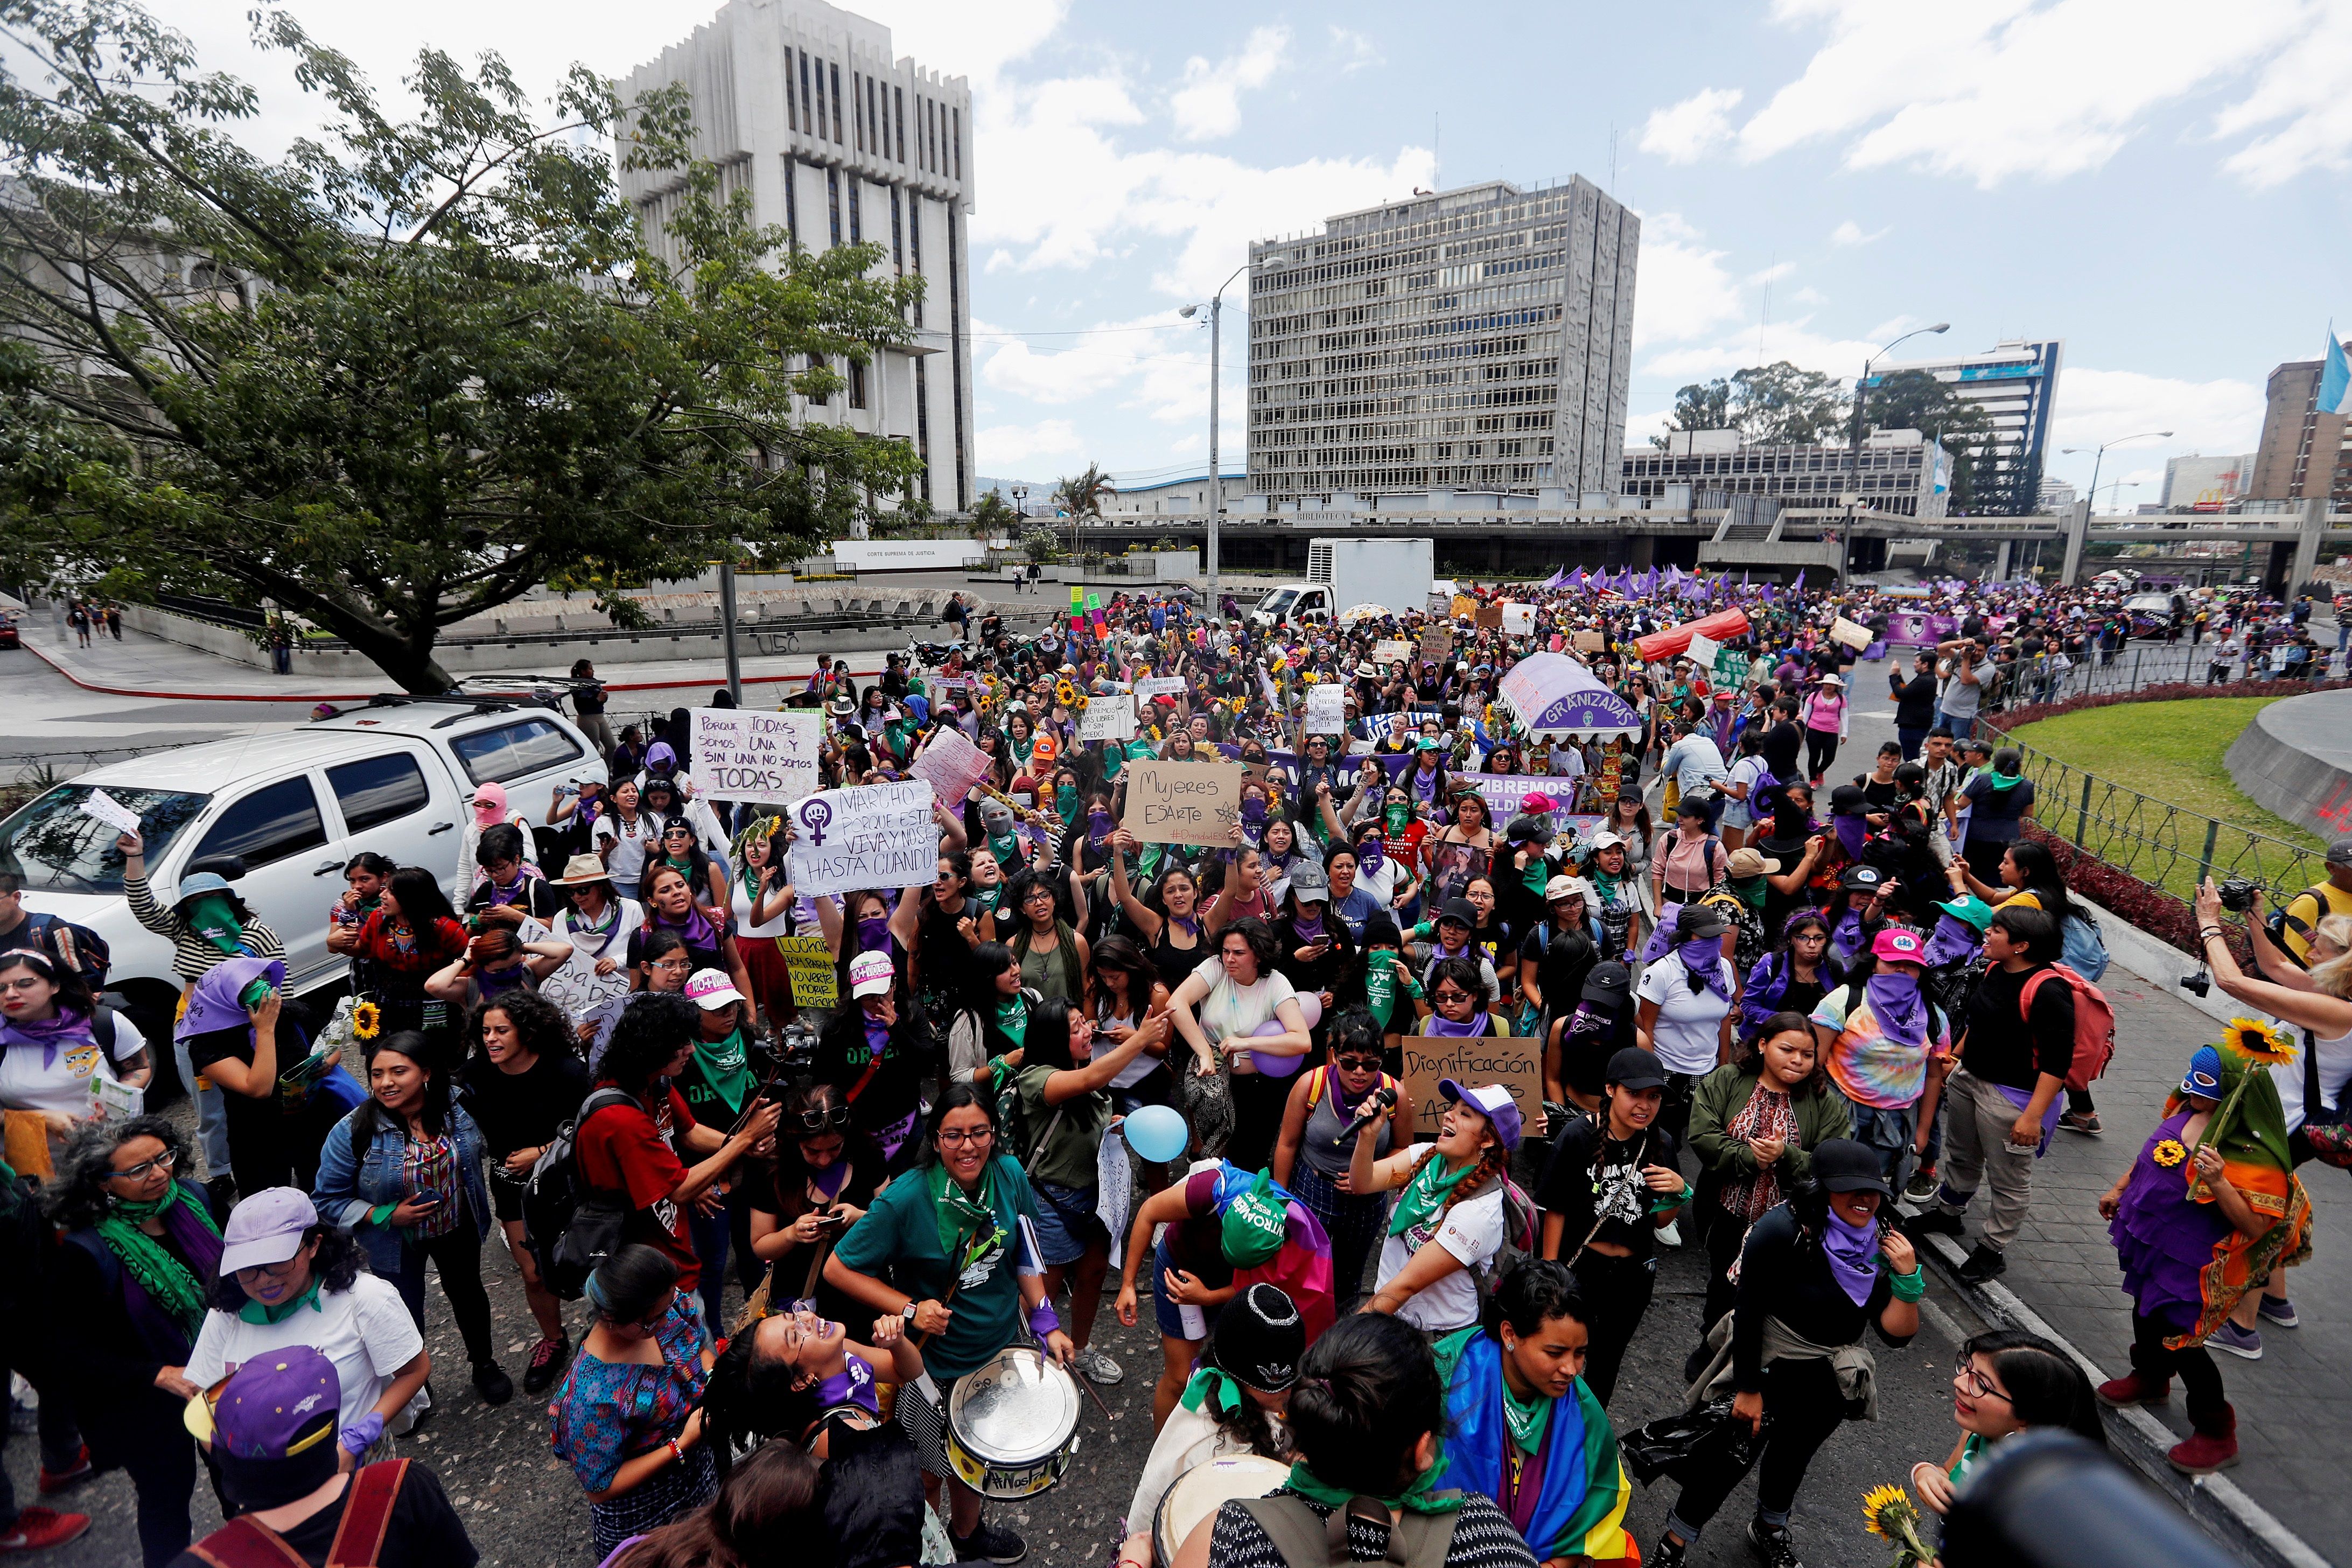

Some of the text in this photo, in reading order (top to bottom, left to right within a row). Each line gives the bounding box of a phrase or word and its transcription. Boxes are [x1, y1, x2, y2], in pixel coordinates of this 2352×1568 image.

[1425, 634, 1445, 642] MEMORIA
[1146, 679, 1163, 688] llegado
[1084, 706, 1116, 716] UEREMOS
[1545, 693, 1633, 726] GRANIZADAS
[702, 716, 795, 734] PORQUE TODAS
[1081, 730, 1104, 738] MIEDO
[698, 735, 798, 752] SOMOS UNA Y
[932, 735, 949, 753] NO
[941, 738, 967, 767] MUJER
[704, 752, 812, 769] SIN UNA NO SOMOS
[711, 768, 782, 789] TODAS
[936, 747, 975, 797] PARA MORIR
[1140, 771, 1219, 802] Mujeres
[1465, 776, 1571, 796] MBREMOS
[839, 786, 914, 814] MARCHO
[842, 808, 934, 835] PORQUE ESTOY
[844, 831, 890, 855] VIVA
[889, 831, 899, 849] Y
[807, 846, 932, 883] HASTA CUANDO
[786, 955, 831, 971] HOY PARA
[712, 974, 730, 986] VIOLE
[789, 970, 804, 982] NO
[1591, 1014, 1612, 1025] RESISTENCIA
[1405, 1046, 1535, 1080] Dignificación
[950, 1200, 961, 1209] legal
[960, 1207, 970, 1215] para
